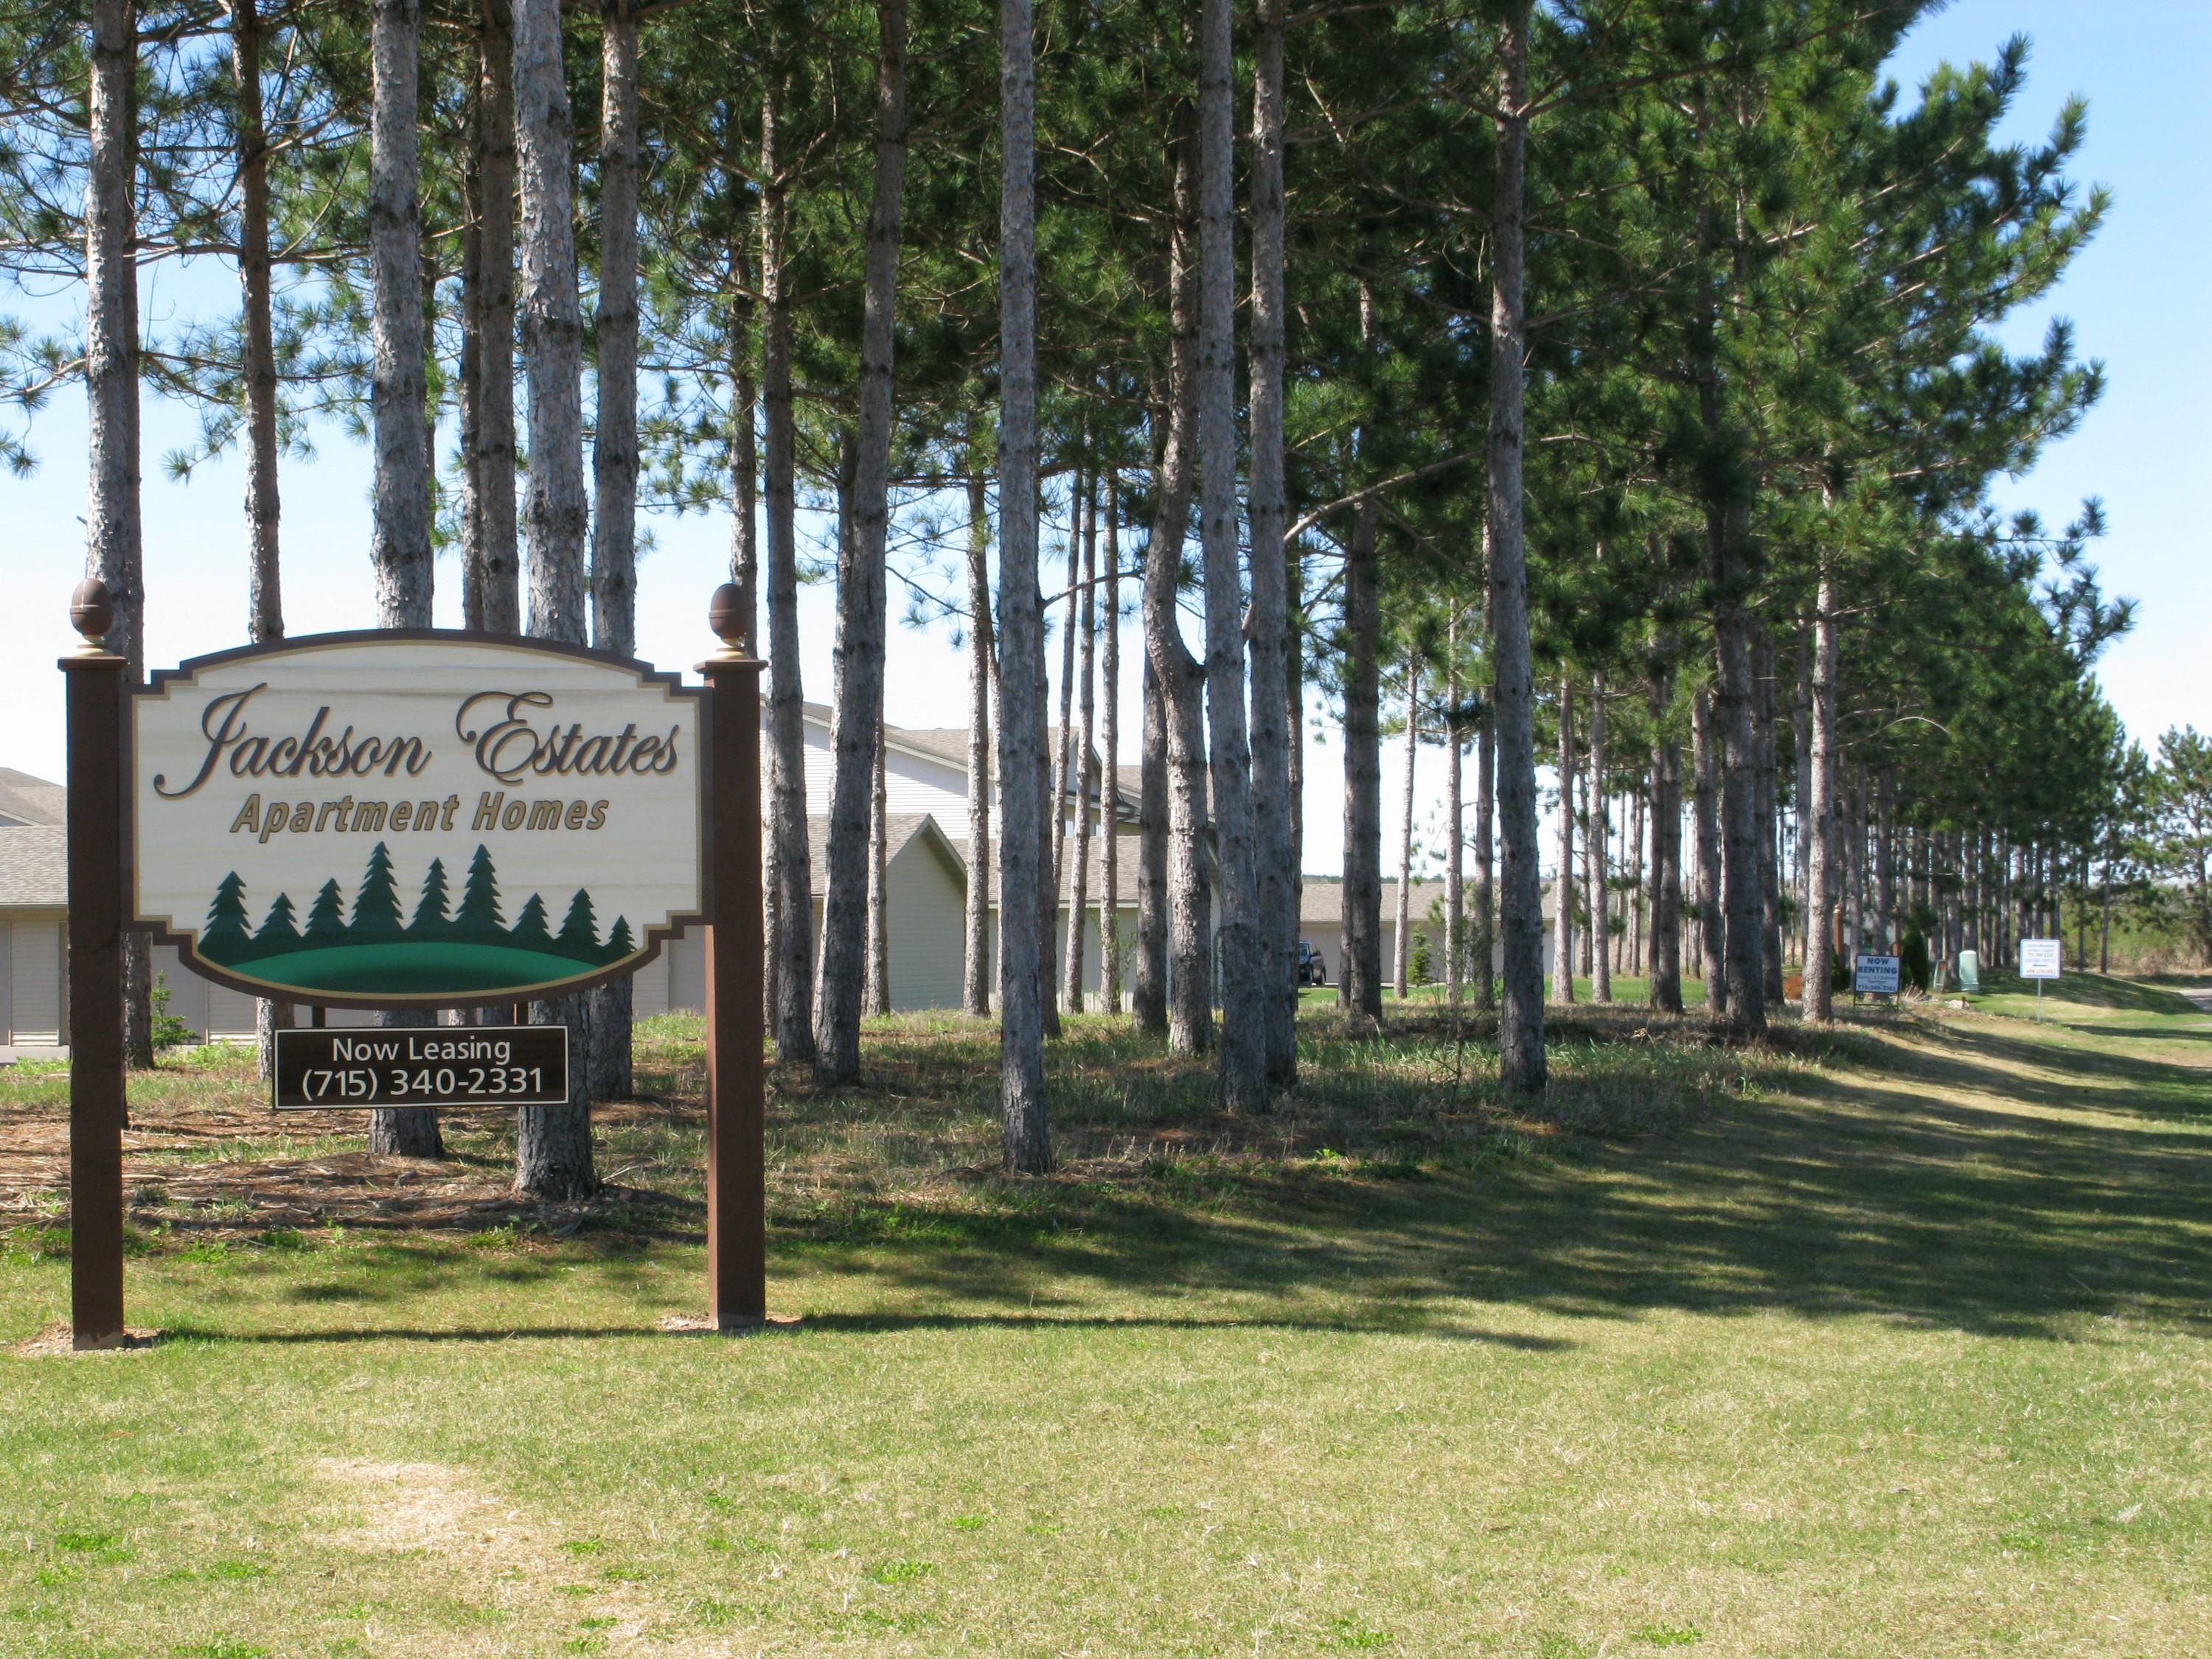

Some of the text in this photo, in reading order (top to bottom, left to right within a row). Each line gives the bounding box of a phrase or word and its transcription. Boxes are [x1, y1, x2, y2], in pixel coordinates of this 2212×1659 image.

[153, 682, 680, 800] Jackson Estates
[230, 791, 610, 843] Apartment Homes
[1858, 966, 1897, 974] RENTING
[333, 1036, 511, 1065] Now Leasing
[302, 1067, 543, 1102] (715) 340-2331
